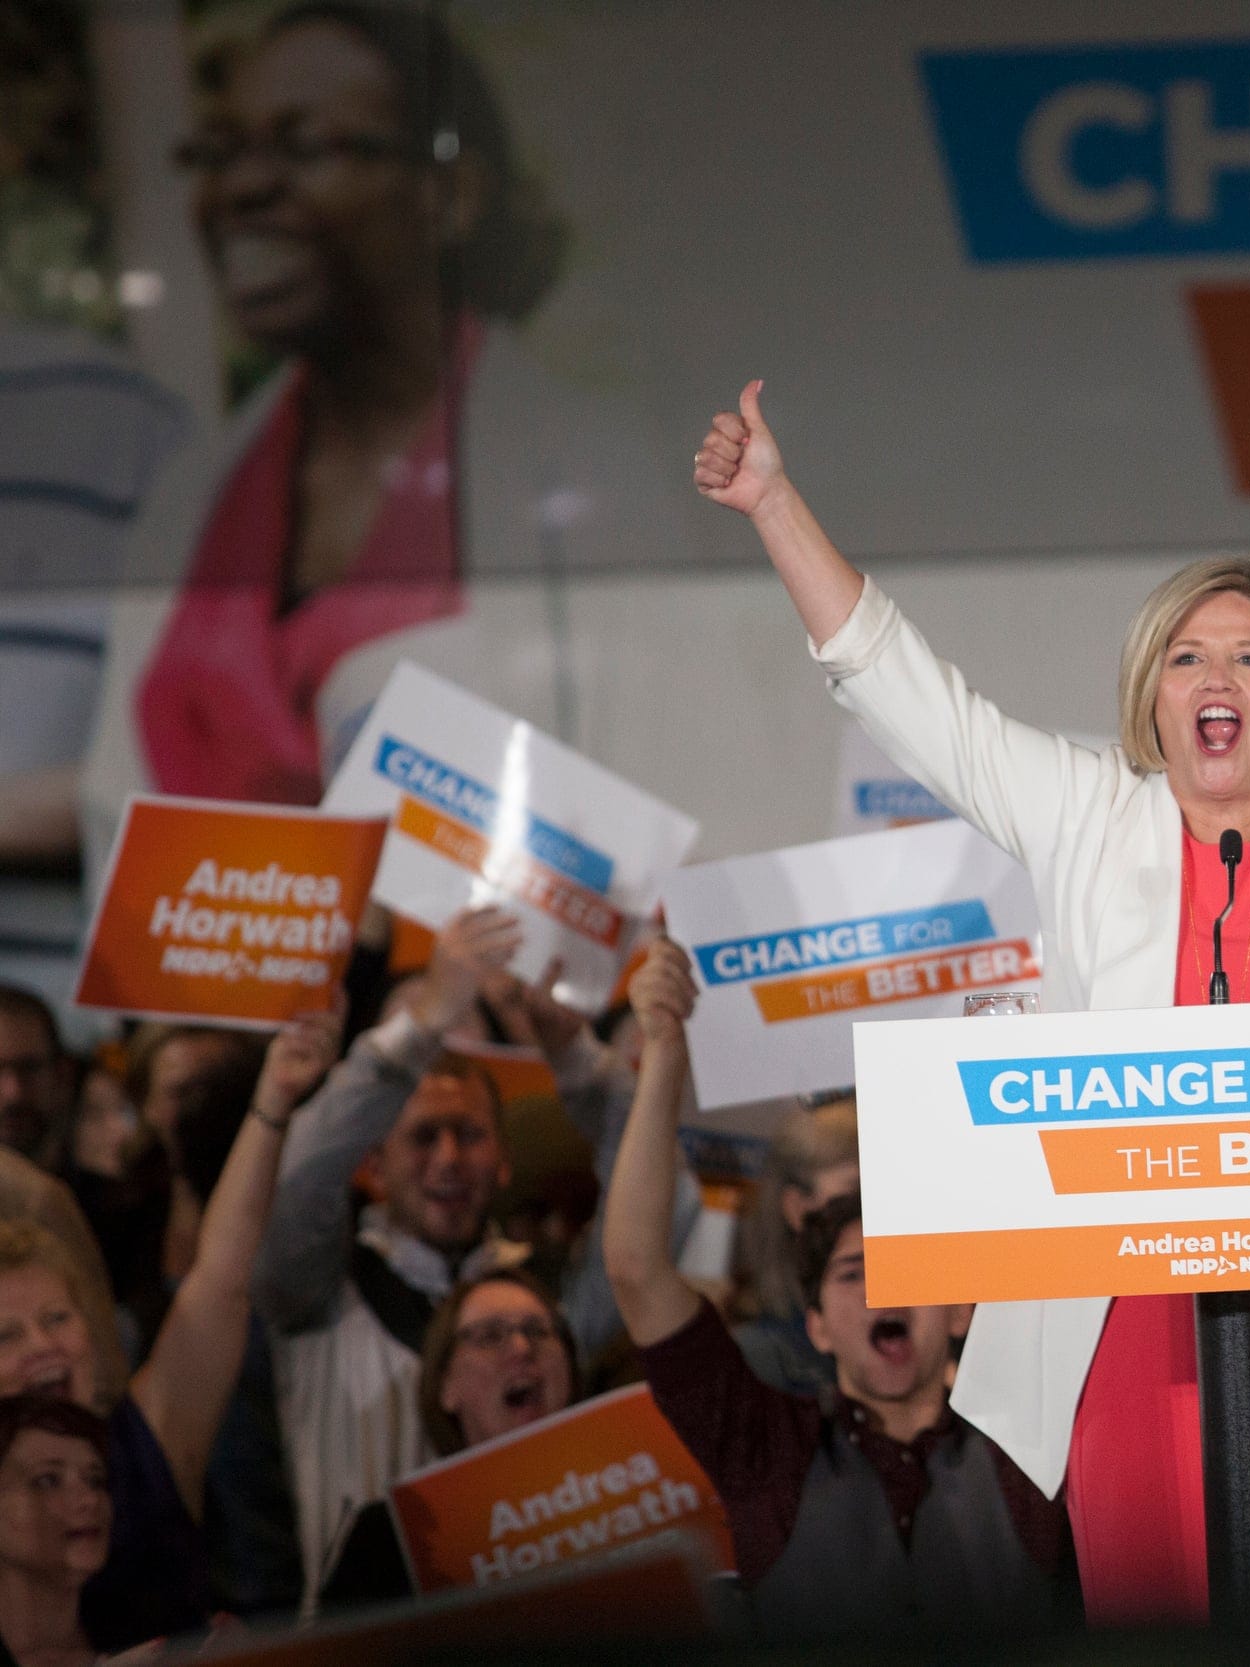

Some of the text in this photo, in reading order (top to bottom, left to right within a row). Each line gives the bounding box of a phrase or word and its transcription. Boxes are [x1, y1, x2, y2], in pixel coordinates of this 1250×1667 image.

[183, 858, 341, 907] Andrea
[149, 895, 353, 955] Horwath
[712, 918, 953, 979] CHANGE FOR
[804, 948, 1022, 1012] THE BETTER
[989, 1059, 1247, 1114] CHANGE
[1116, 1145, 1201, 1180] THE
[1117, 1233, 1216, 1256] Andrea
[1170, 1257, 1218, 1276] NDP
[488, 1452, 660, 1542] Andrea
[470, 1478, 700, 1587] Horwath
